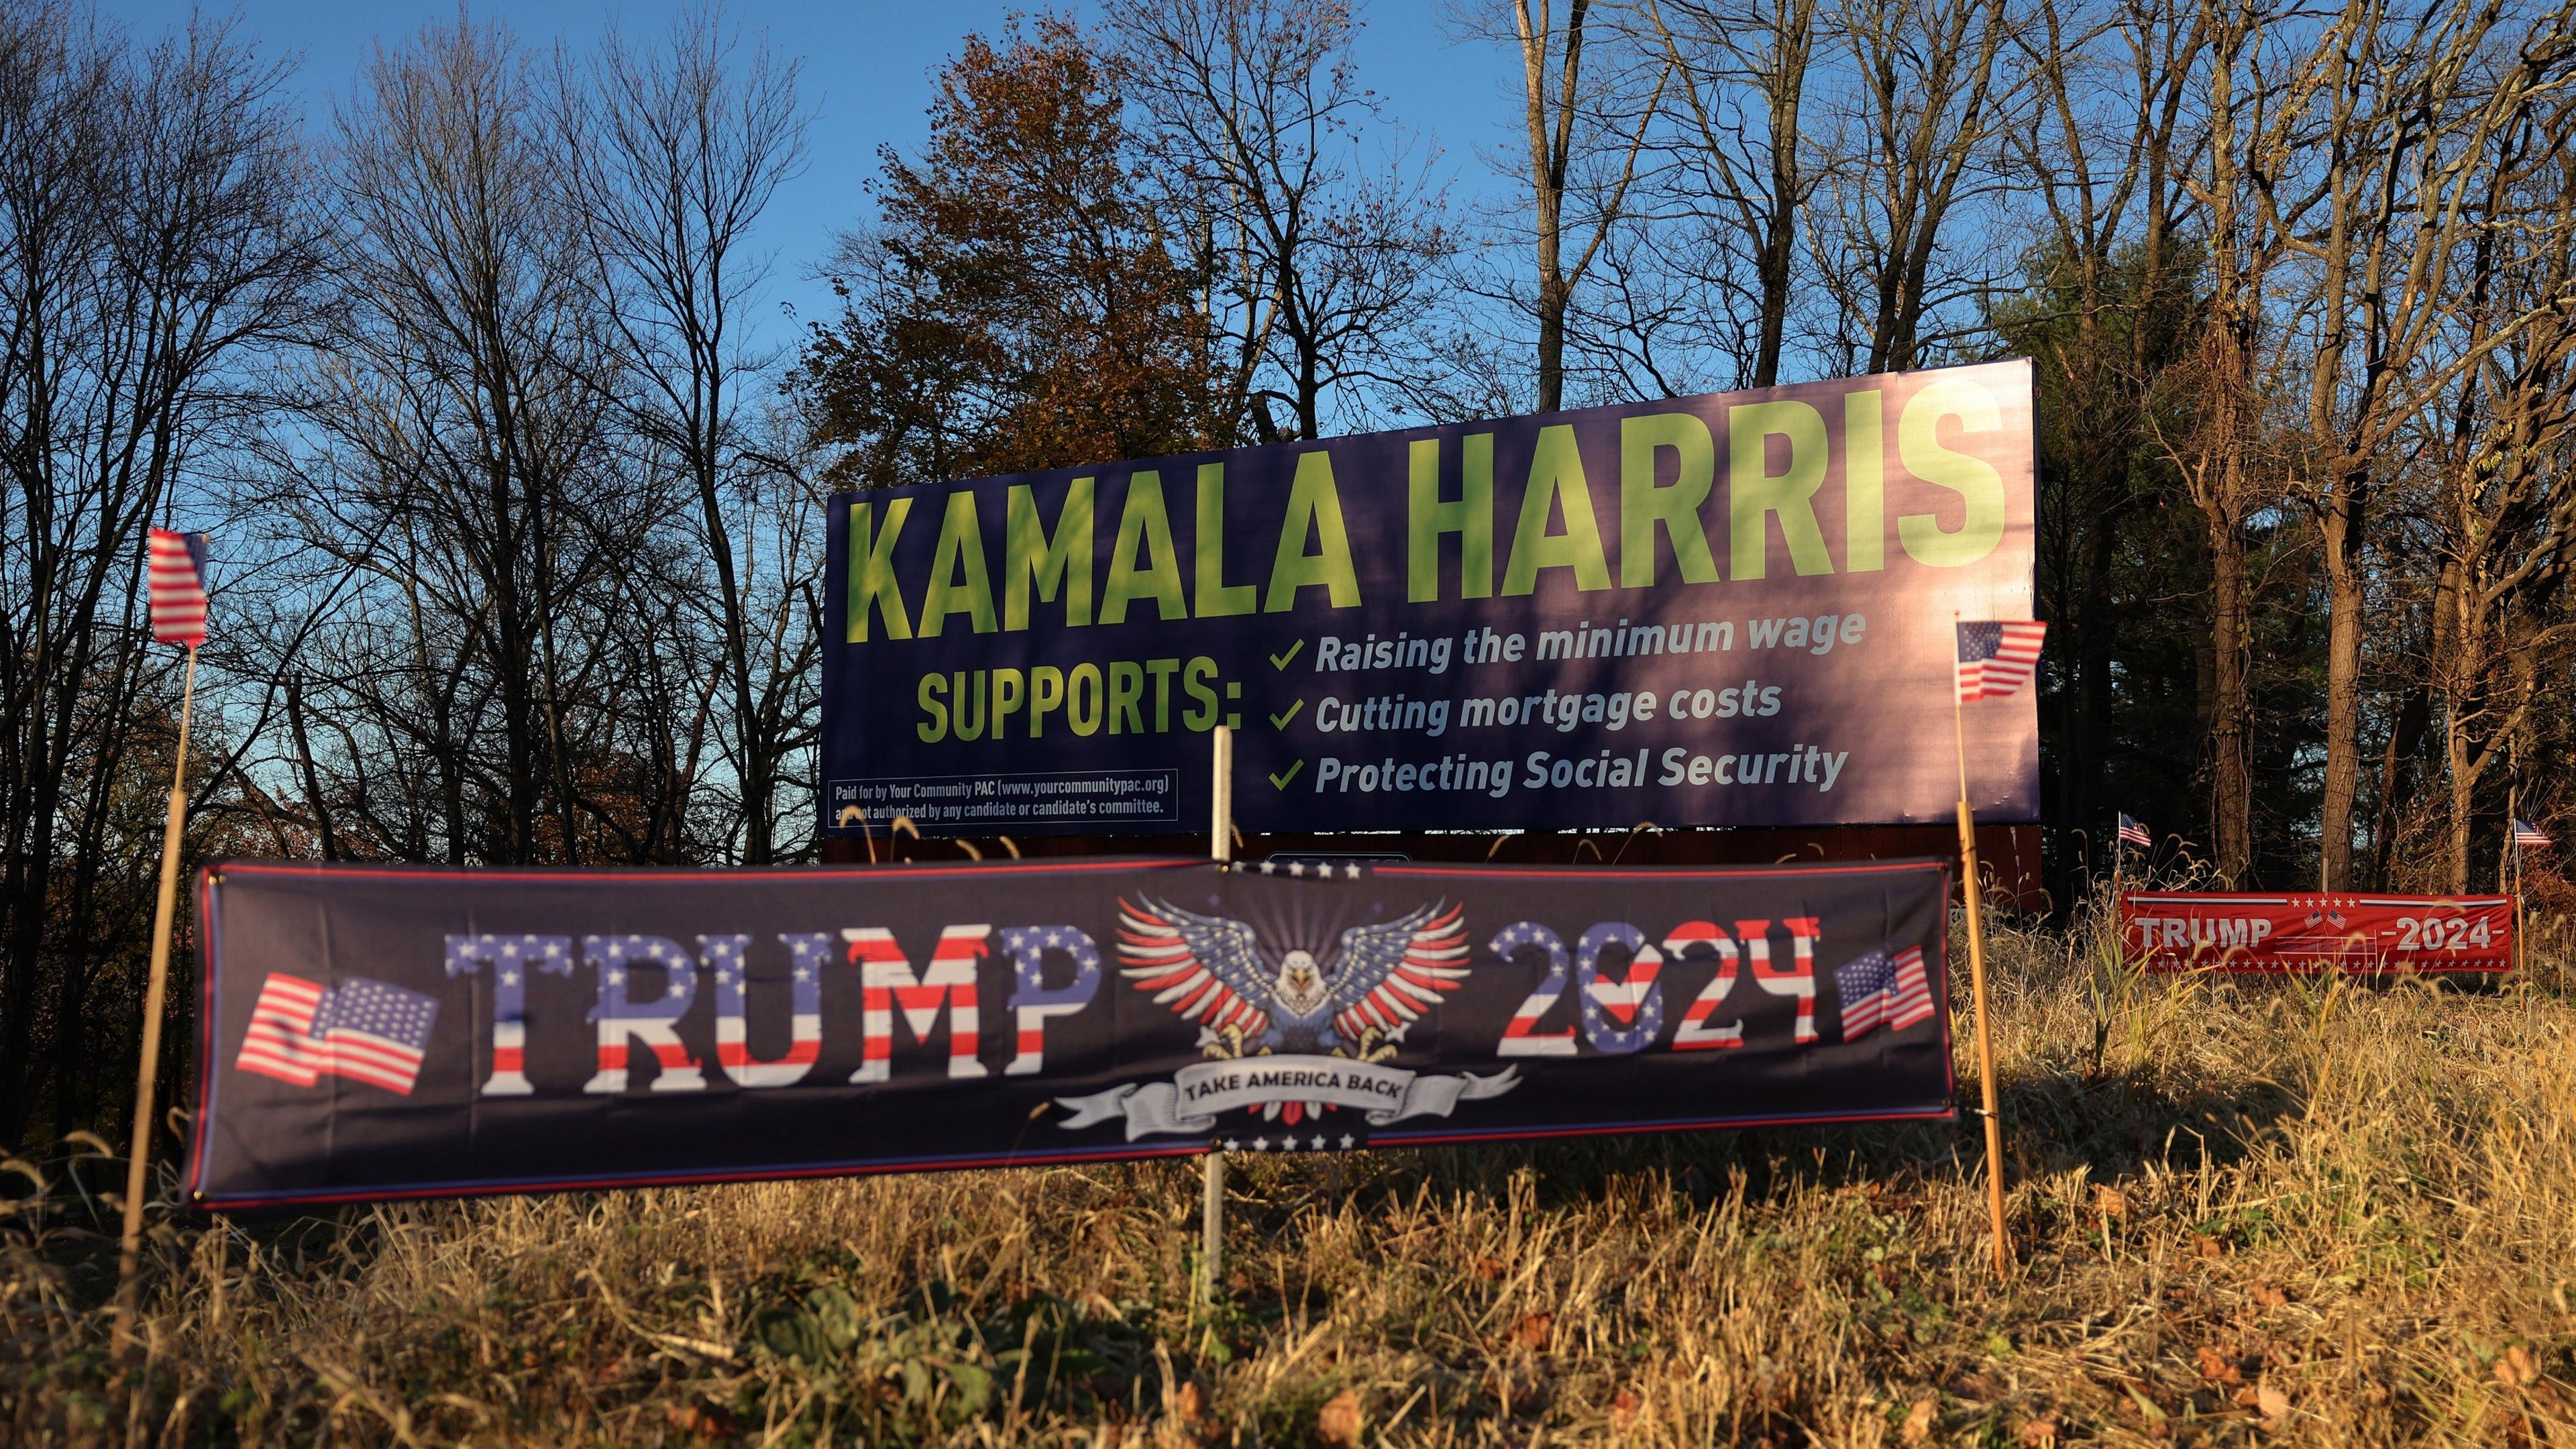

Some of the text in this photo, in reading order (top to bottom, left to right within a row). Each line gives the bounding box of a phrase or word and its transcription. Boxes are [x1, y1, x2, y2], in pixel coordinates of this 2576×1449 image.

[847, 378, 2005, 643] KAMALA HARRIS
[1316, 613, 1866, 674] Raising the minimum wage
[916, 655, 1242, 743] SUPPORTS:
[1316, 680, 1782, 737] Cutting mortgage costs
[836, 774, 1169, 801] Paid for by Your Community PAC (www.yourcommunitypac.org)
[1316, 744, 1849, 798] Protecting Social Security
[873, 804, 926, 819] authorized
[928, 804, 941, 820] by
[943, 806, 961, 820] any
[964, 802, 1016, 816] candidate
[1019, 804, 1030, 816] or
[1032, 800, 1096, 816] candidate's
[1099, 798, 1163, 814] committee.
[2135, 918, 2272, 948] TRUMP
[444, 916, 1821, 1094] TRUMP 2024
[1184, 1071, 1402, 1101] TAKE AMERICA BACK
